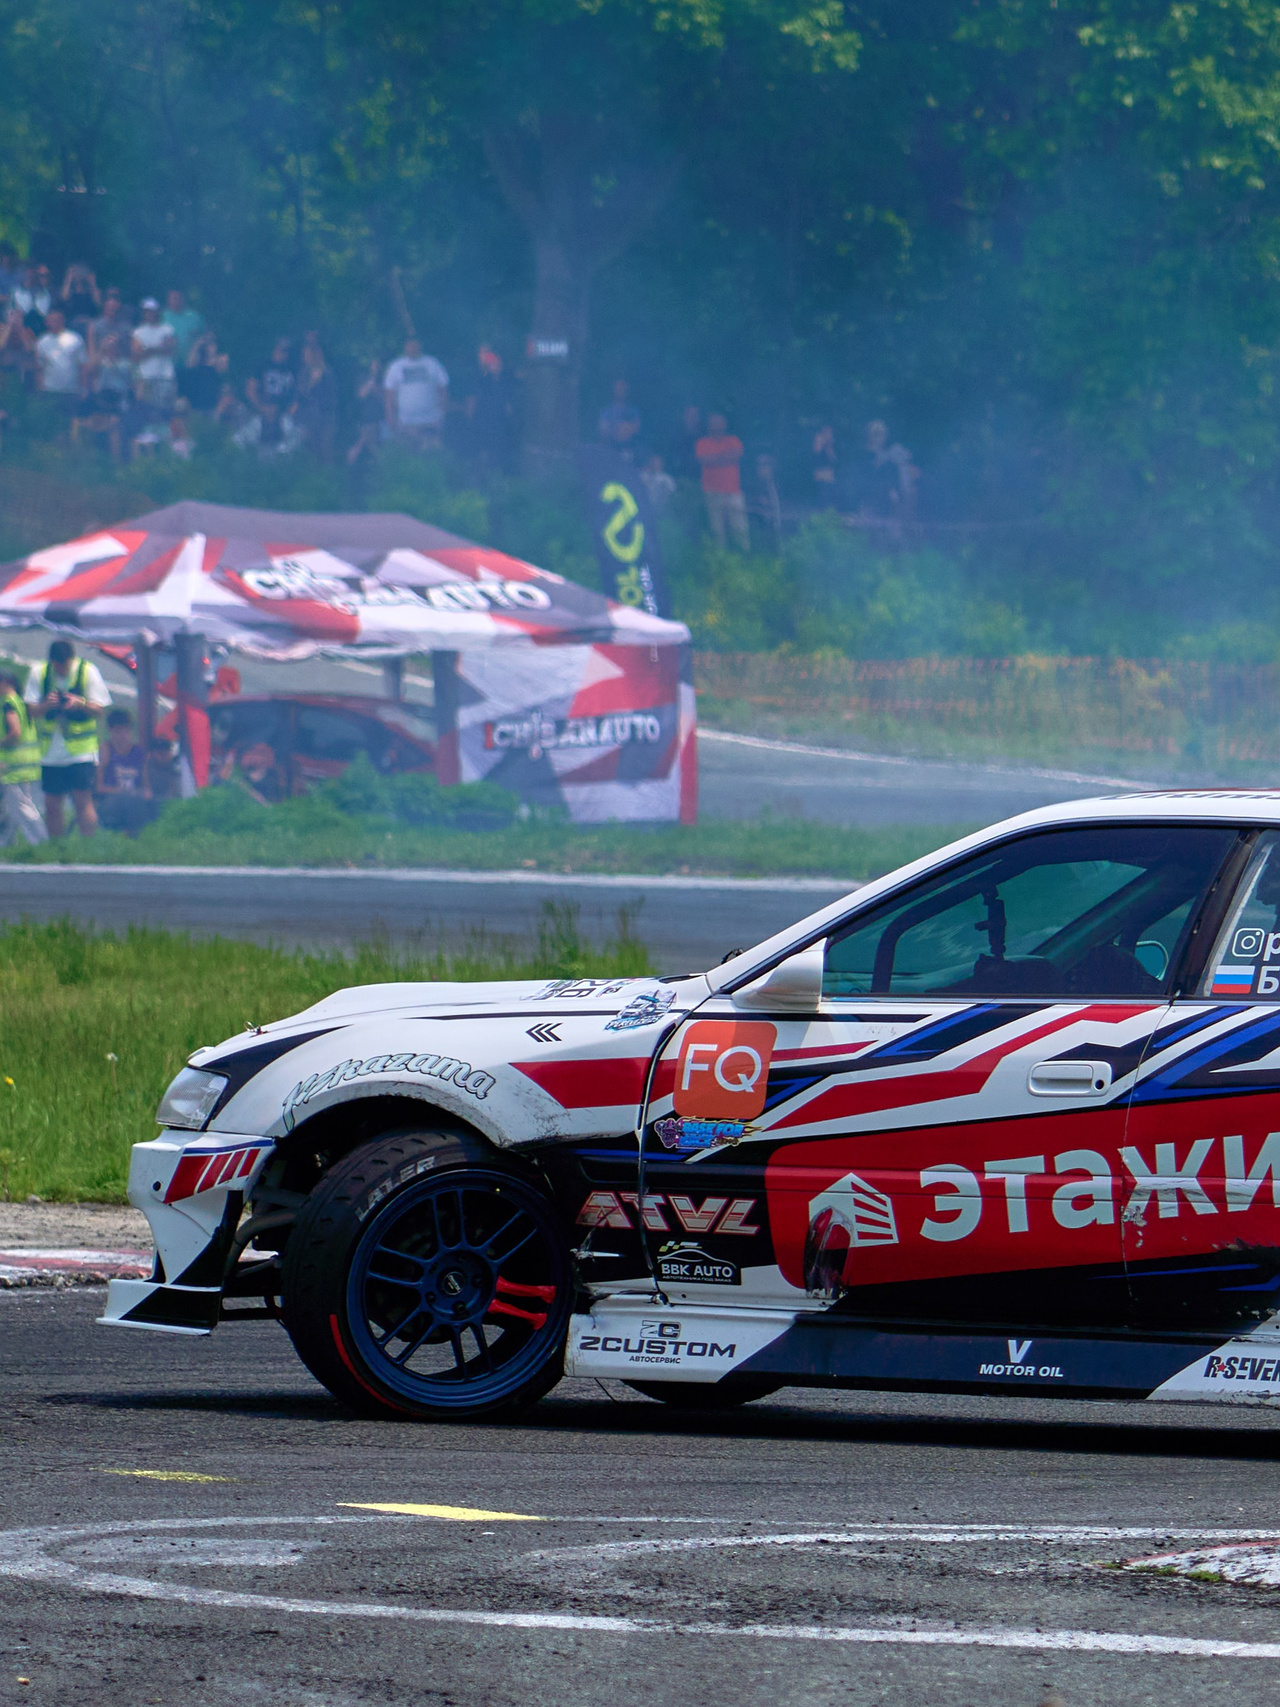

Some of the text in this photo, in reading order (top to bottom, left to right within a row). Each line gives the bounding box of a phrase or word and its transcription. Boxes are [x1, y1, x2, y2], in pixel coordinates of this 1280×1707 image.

[681, 1043, 762, 1093] FQ
[694, 1265, 733, 1278] AUTO
[629, 1355, 682, 1364] АВТОСЕРВИС
[979, 1364, 1064, 1378] MOTOR OIL
